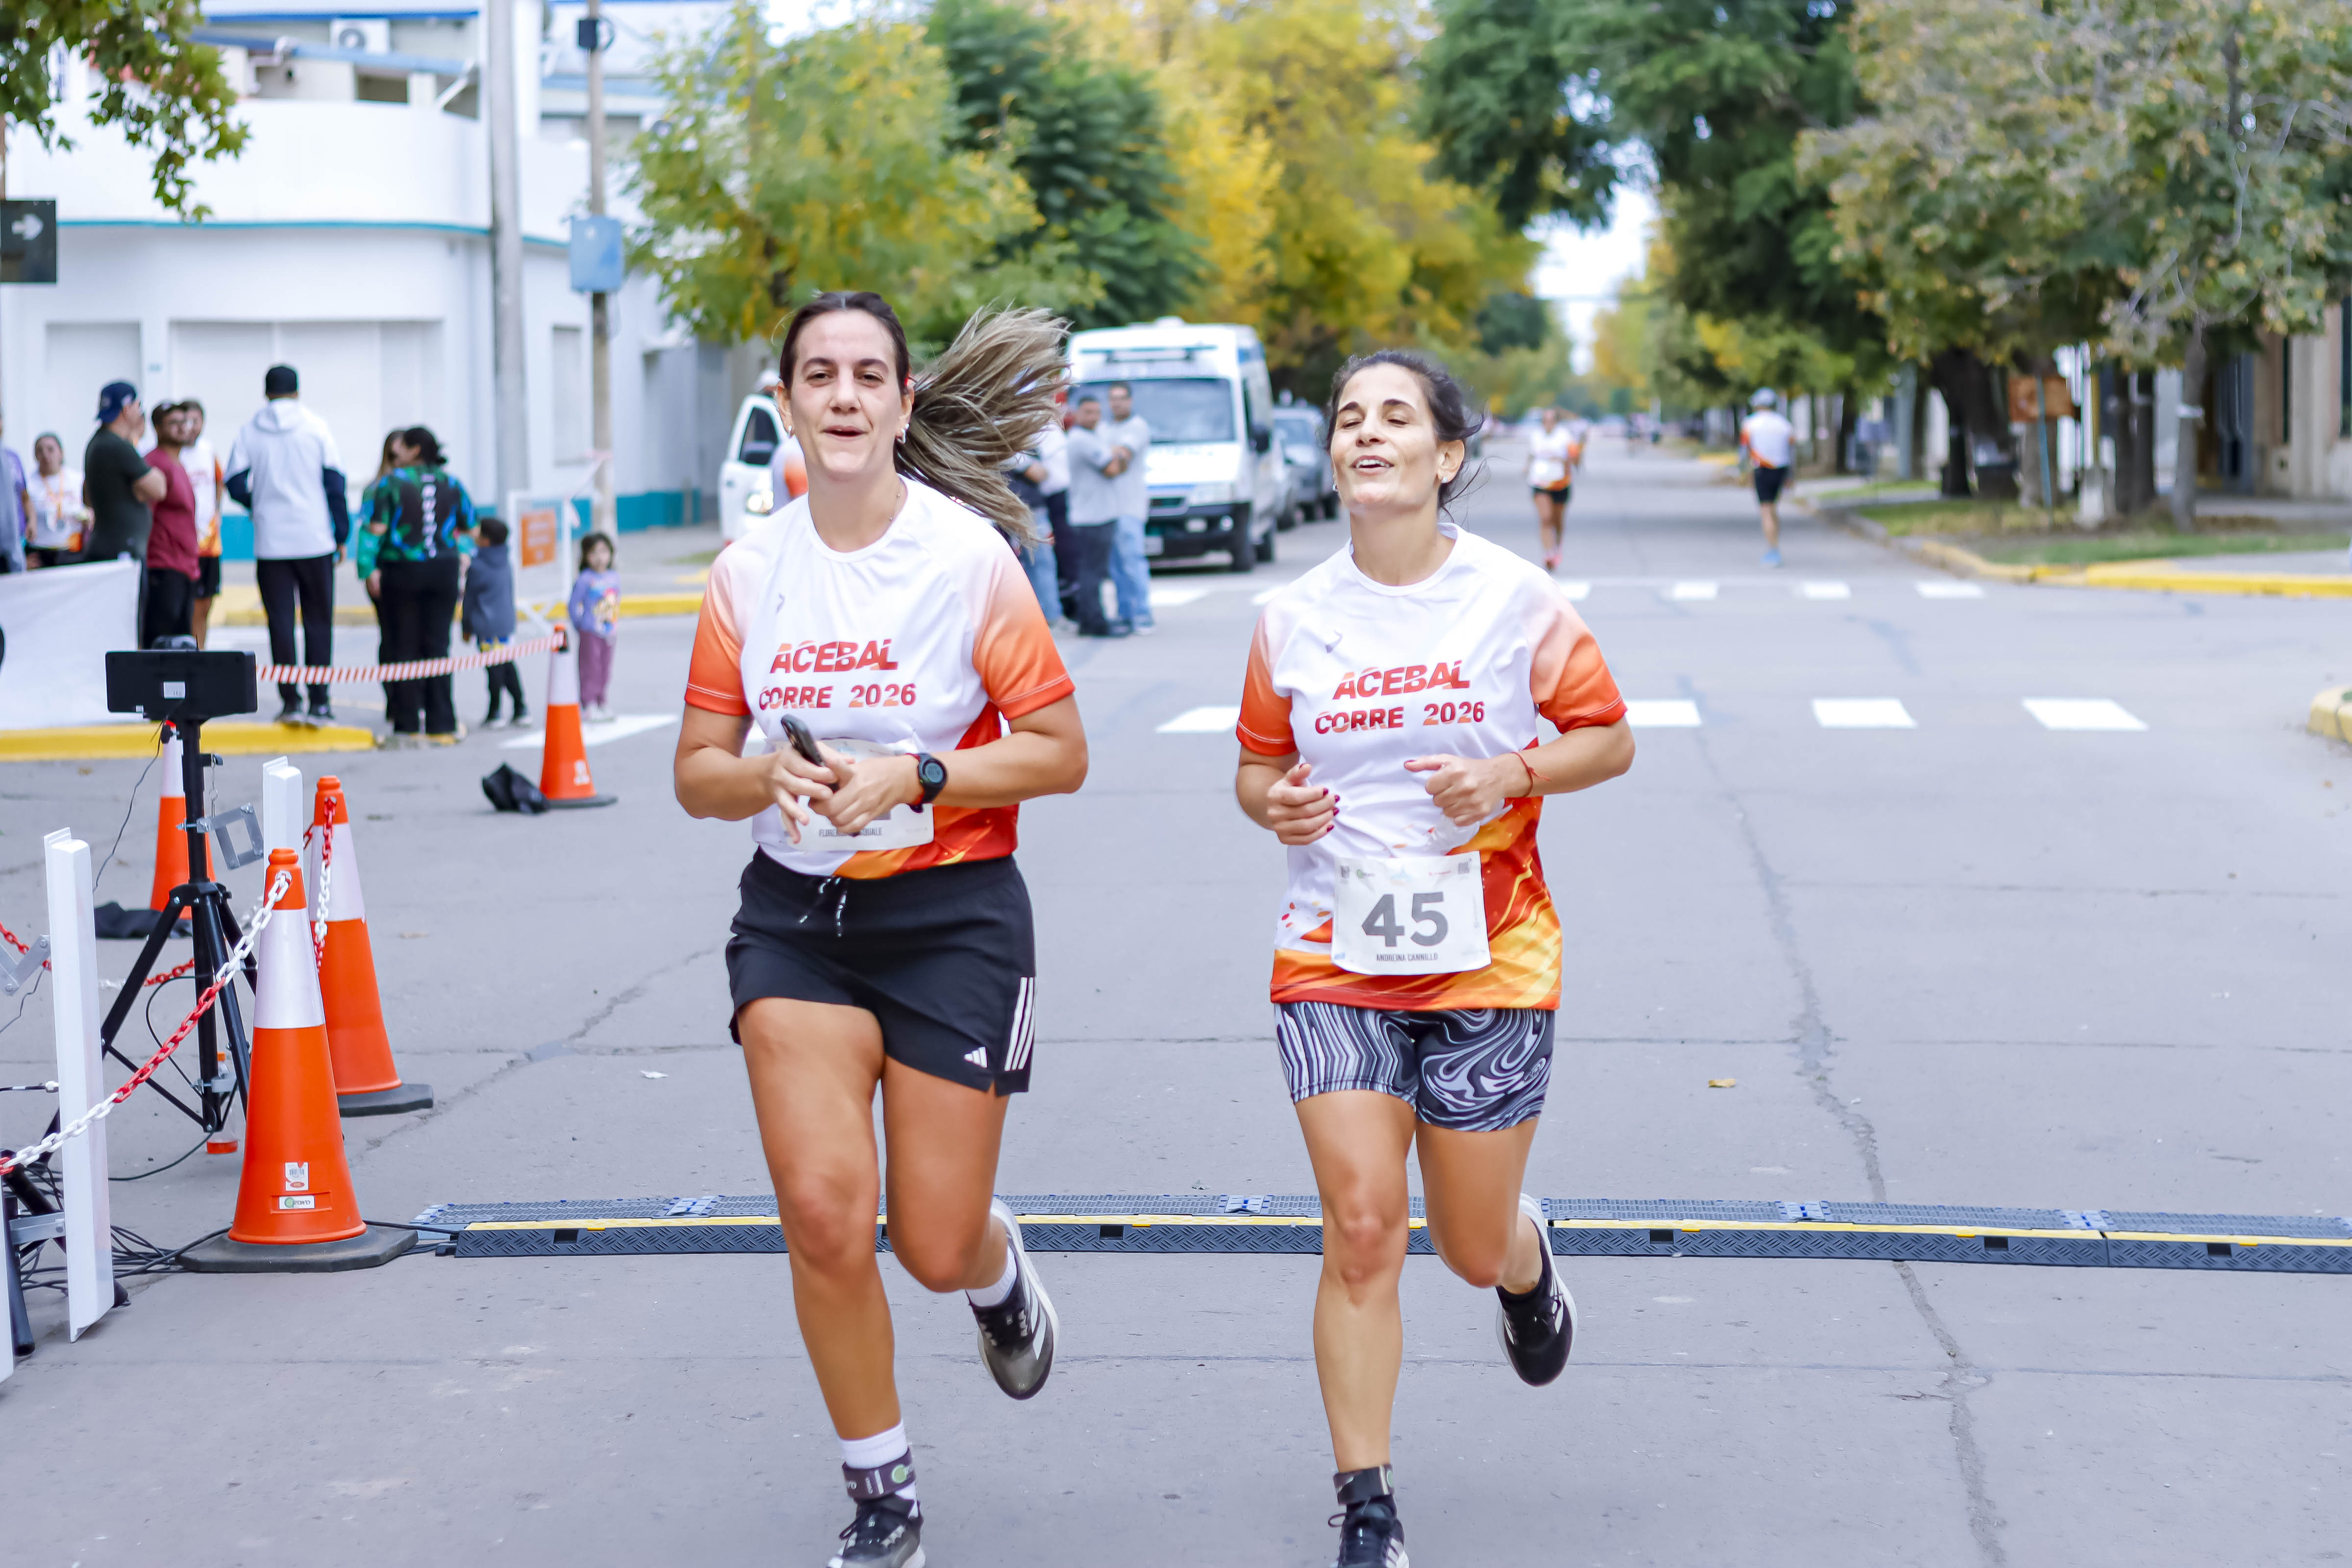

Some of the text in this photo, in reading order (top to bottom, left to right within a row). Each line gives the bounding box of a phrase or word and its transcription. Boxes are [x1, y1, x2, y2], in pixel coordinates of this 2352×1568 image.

[770, 639, 899, 674] ACEBAL
[759, 683, 916, 710] CORRE 2026
[1332, 660, 1470, 700] ACEBAL
[1315, 701, 1485, 734] CORRE 2026
[1361, 891, 1448, 947] 45
